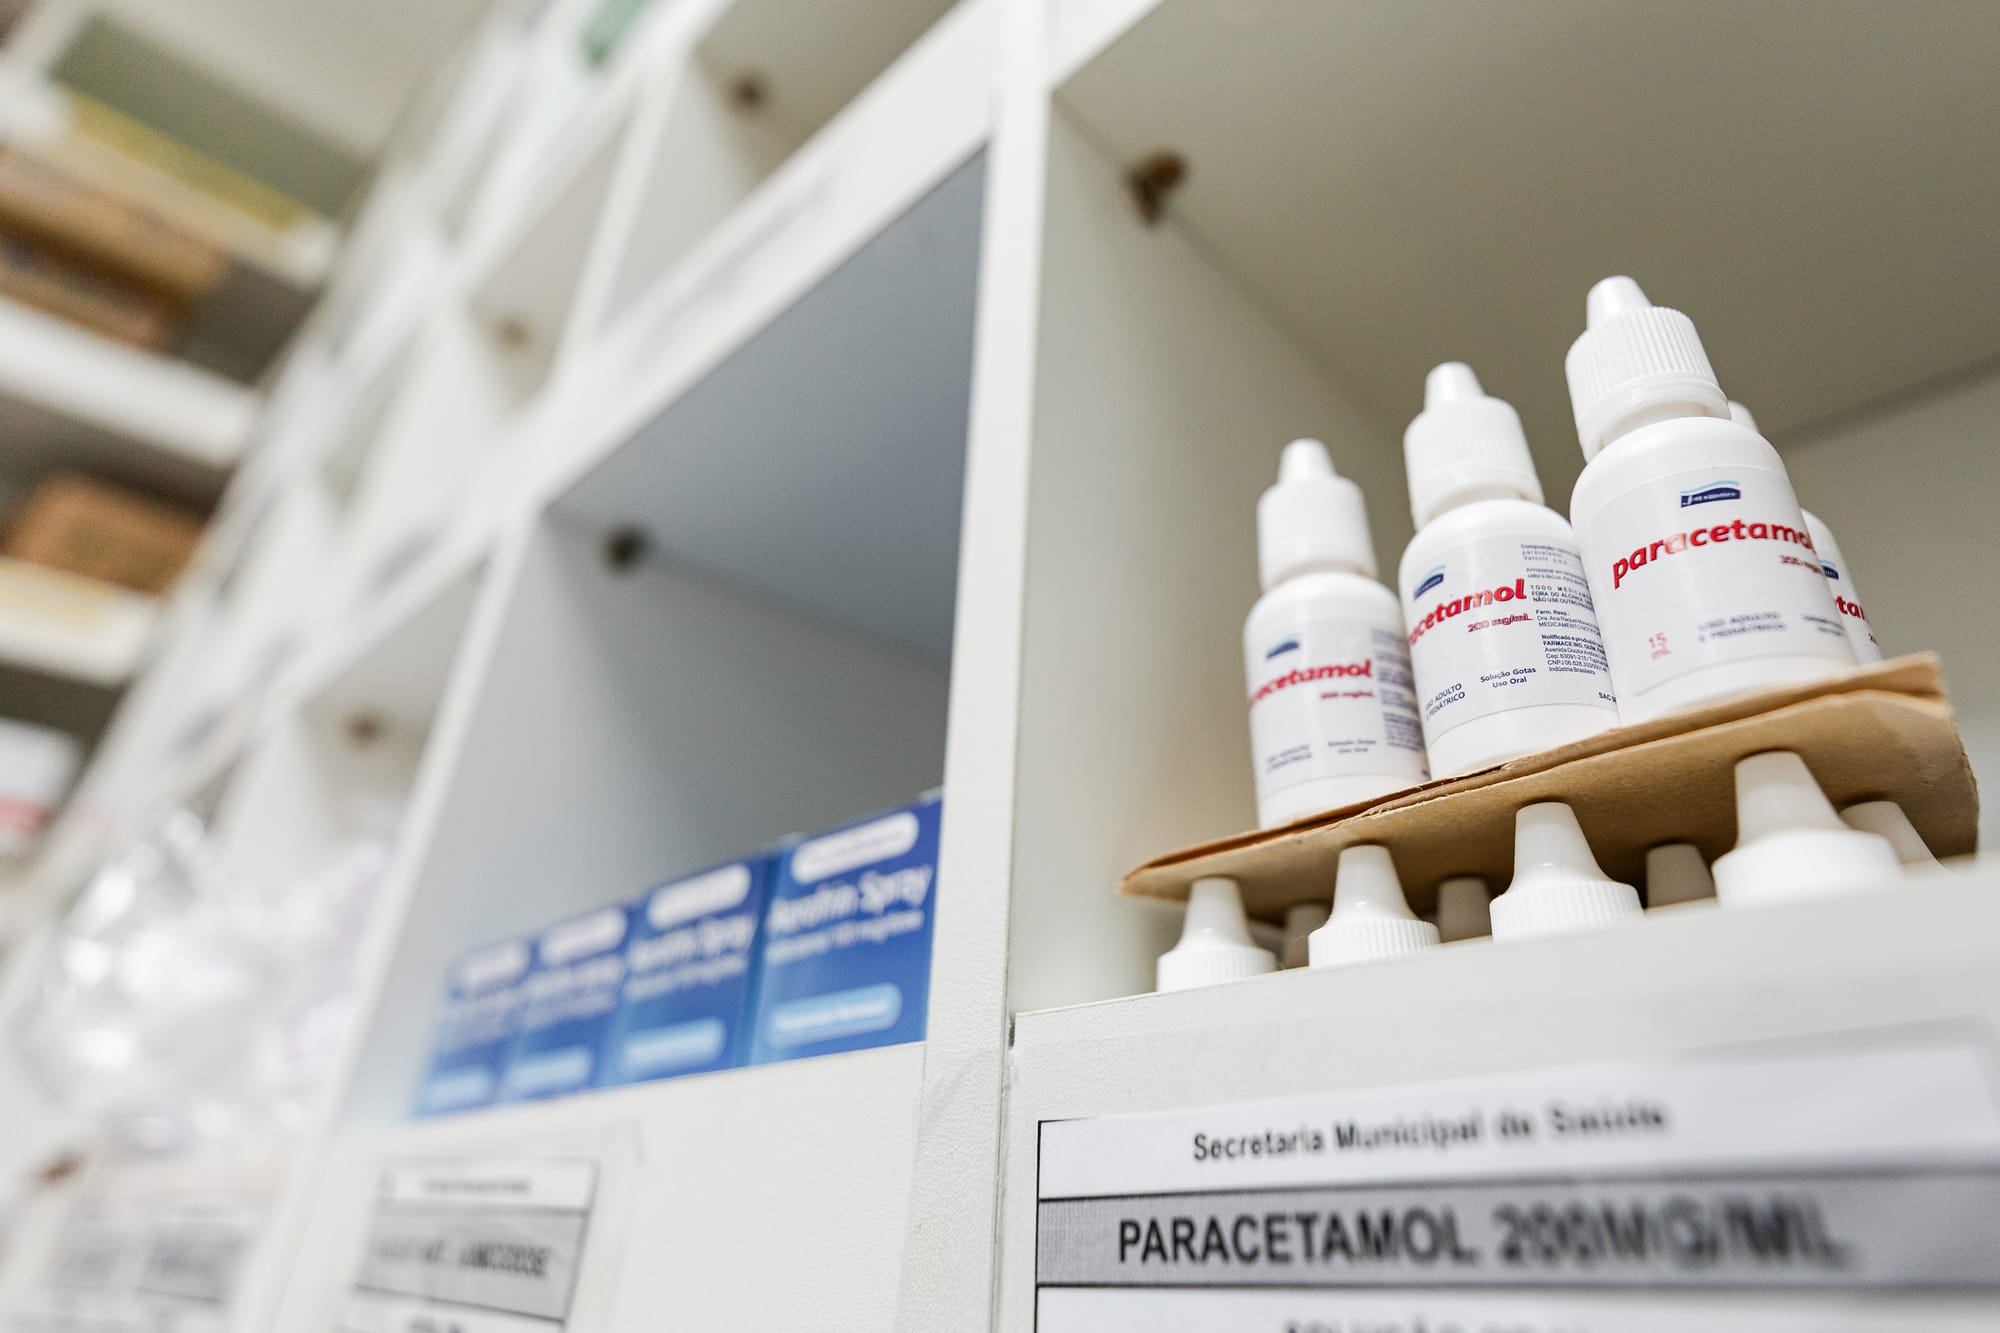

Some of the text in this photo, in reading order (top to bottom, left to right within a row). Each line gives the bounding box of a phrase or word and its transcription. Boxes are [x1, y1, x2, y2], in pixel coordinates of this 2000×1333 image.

[1647, 631, 1667, 648] 15
[1480, 671, 1510, 683] Solução
[1510, 676, 1527, 685] Oral
[1435, 683, 1462, 701] ADULTO
[1193, 1124, 1325, 1163] Secretaria
[1335, 1109, 1483, 1151] Municipal
[1499, 1107, 1532, 1137] de
[1118, 1198, 1852, 1271] PARACETAMOL 200MG/ML
